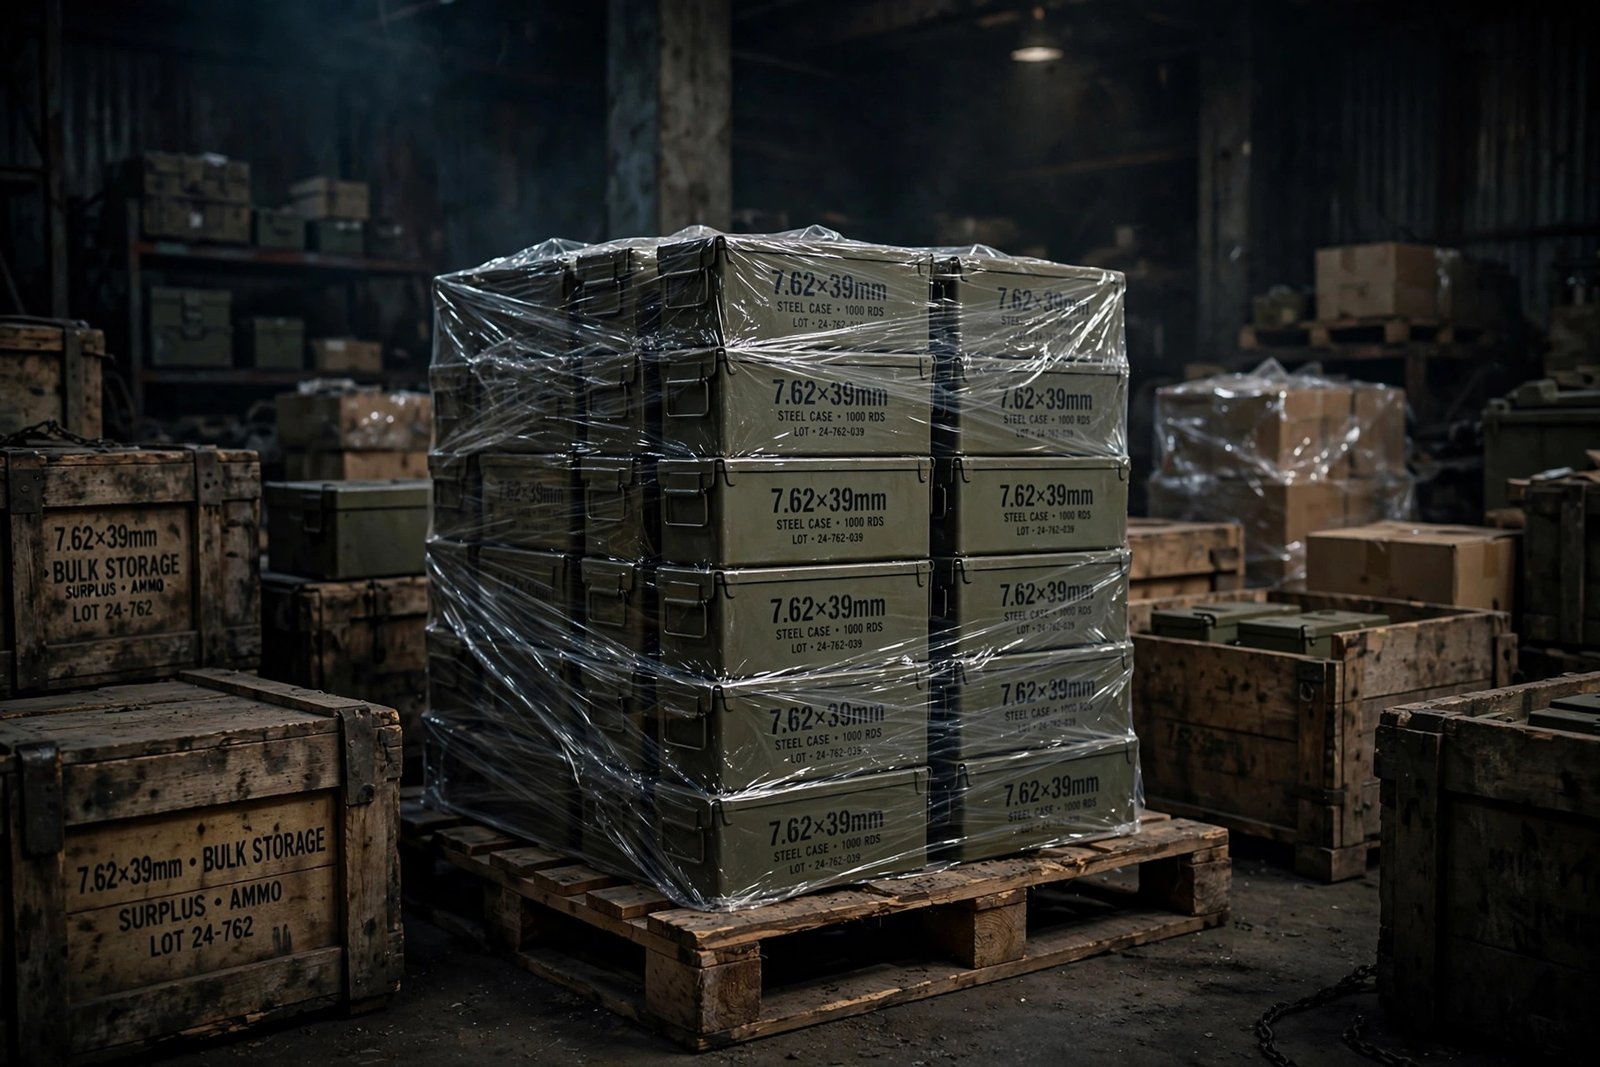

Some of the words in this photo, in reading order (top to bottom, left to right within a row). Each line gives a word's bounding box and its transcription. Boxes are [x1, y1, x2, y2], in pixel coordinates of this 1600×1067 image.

[772, 270, 887, 300] 7.62×39mm
[778, 301, 805, 313] STEEL
[809, 303, 832, 314] CASE
[845, 305, 864, 316] 1000
[867, 306, 884, 317] RDS
[793, 318, 808, 328] LOT
[772, 379, 888, 406] 7.62×39mm
[1000, 386, 1092, 410] 7.62×39mm
[778, 410, 806, 421] STEEL
[809, 411, 833, 422] CASE
[846, 411, 865, 422] 1000
[869, 411, 885, 422] RDS
[1003, 414, 1026, 424] STEEL
[1029, 415, 1048, 425] CASE
[794, 427, 809, 437] LOT
[819, 427, 865, 437] 24-762-039
[771, 487, 887, 513] 7.62×39mm
[1000, 484, 1093, 508] 7.62×39mm
[776, 518, 805, 530] STEEL
[808, 518, 832, 529] CASE
[844, 517, 864, 528] 1000
[867, 516, 884, 527] RDS
[1004, 512, 1027, 522] STEEL
[1030, 511, 1048, 521] CASE
[1059, 511, 1075, 520] 1000
[1078, 510, 1091, 520] RDS
[54, 524, 157, 551] 7.62×39mm
[792, 534, 807, 545] LOT
[817, 533, 864, 544] 24-762-039
[1016, 526, 1030, 536] LOT
[53, 558, 99, 584] BULK
[105, 554, 180, 579] STORAGE
[65, 582, 116, 599] SURPLUS
[130, 578, 164, 594] AMMO
[73, 604, 100, 623] LOT
[105, 600, 153, 620] 24-762
[770, 594, 886, 624] 7.62×39mm
[1004, 611, 1028, 621] STEEL
[776, 627, 804, 640] STEEL
[808, 625, 831, 637] CASE
[844, 623, 864, 634] 1000
[866, 622, 883, 633] RDS
[792, 641, 807, 654] LOT
[816, 639, 863, 651] 24-762-039
[1000, 679, 1095, 706] 7.62×39mm
[769, 702, 885, 735] 7.62×39mm
[1005, 710, 1028, 722] STEEL
[1031, 706, 1050, 718] CASE
[775, 737, 803, 751] STEEL
[806, 734, 830, 747] CASE
[843, 730, 862, 741] 1000
[866, 728, 882, 739] RDS
[790, 752, 806, 764] LOT
[1004, 775, 1099, 807] 7.62×39mm
[769, 809, 884, 846] 7.62×39mm
[774, 847, 802, 863] STEEL
[806, 843, 829, 857] CASE
[842, 838, 861, 849] 1000
[864, 834, 881, 846] RDS
[77, 856, 182, 895] 7.62×39mm
[203, 840, 247, 873] BULK
[252, 827, 326, 864] STORAGE
[789, 862, 805, 875] LOT
[815, 853, 861, 870] 24-762-039
[119, 894, 206, 932] SURPLUS
[230, 880, 282, 911] AMMO
[150, 929, 184, 958] LOT
[192, 915, 254, 949] 24-762
